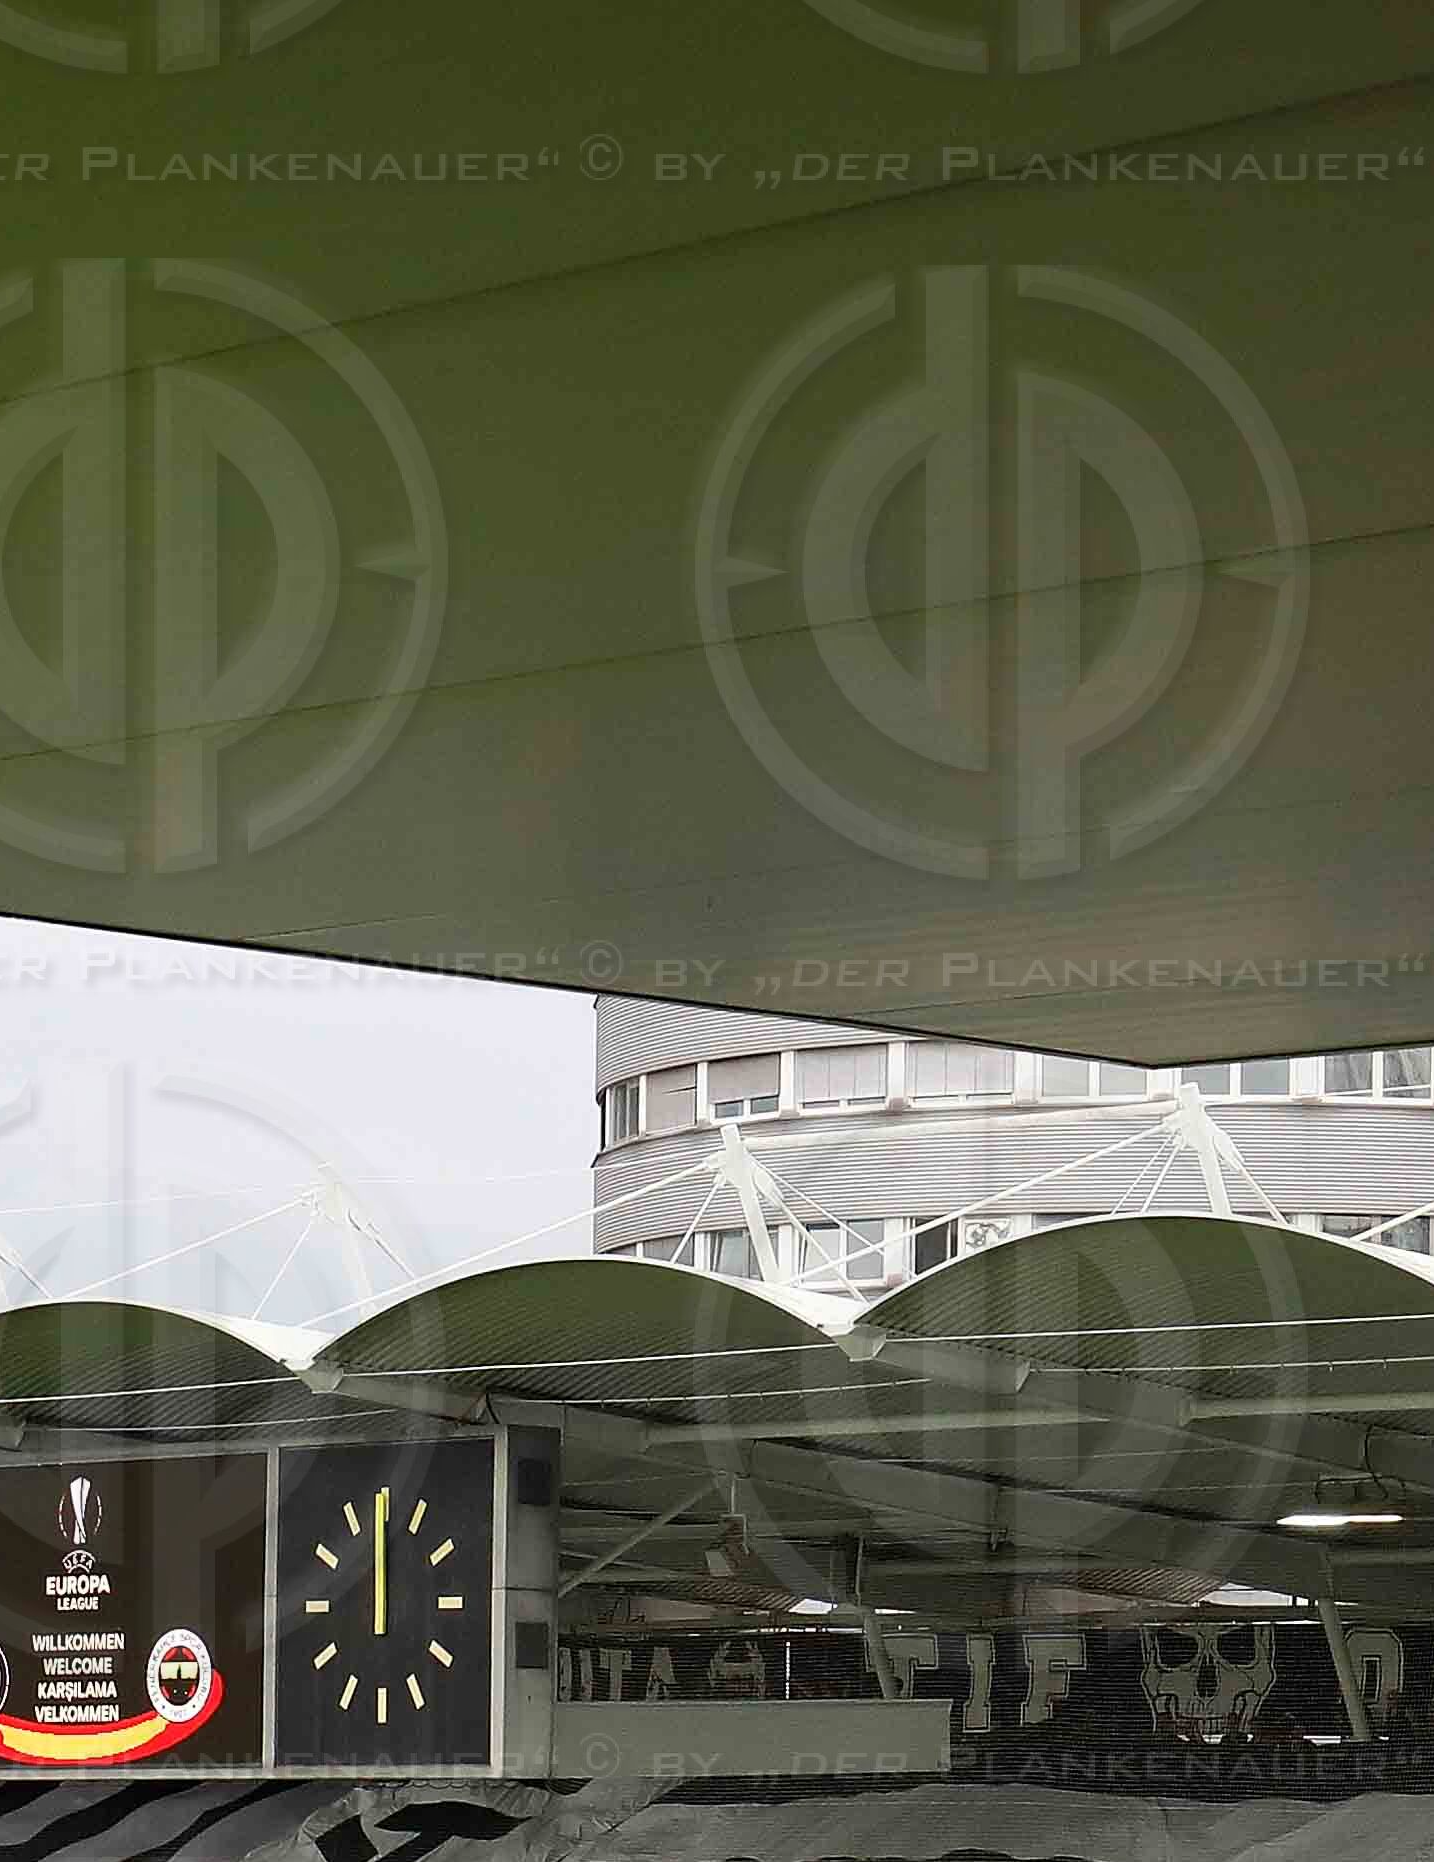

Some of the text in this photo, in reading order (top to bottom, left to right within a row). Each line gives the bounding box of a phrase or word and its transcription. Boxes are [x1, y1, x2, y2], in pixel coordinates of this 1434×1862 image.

[62, 1552, 95, 1570] UEFA
[46, 1574, 111, 1596] EUROPA
[57, 1597, 99, 1611] LEAGUE
[32, 1633, 125, 1652] WILLKOMMEN
[43, 1657, 113, 1676] WELCOME
[38, 1681, 117, 1703] KARŞILAMA
[34, 1704, 120, 1723] VELKOMMEN
